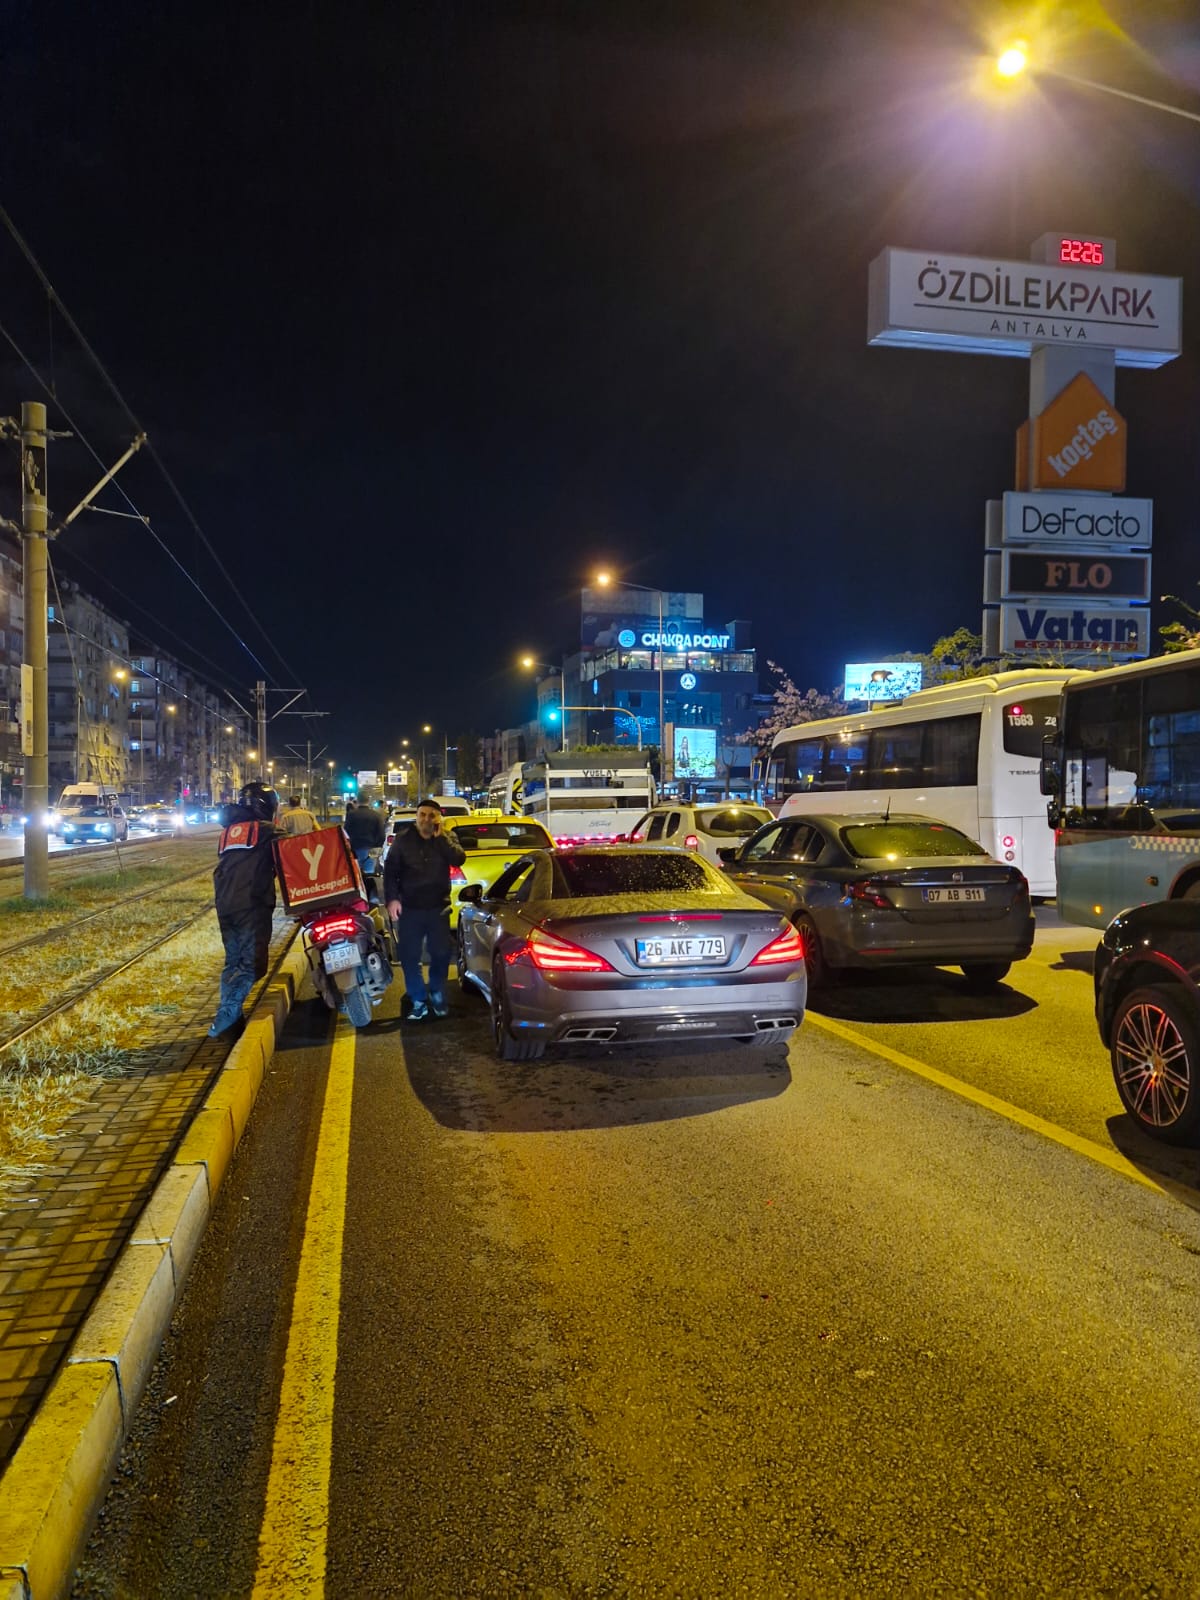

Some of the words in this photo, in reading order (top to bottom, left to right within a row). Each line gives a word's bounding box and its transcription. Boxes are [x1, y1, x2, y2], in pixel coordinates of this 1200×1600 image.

[917, 260, 1155, 319] ÖZDİLEKPARK
[990, 319, 1087, 339] ANTALYA
[1046, 408, 1119, 478] koçtaş
[1022, 505, 1141, 538] DeFacto
[1044, 561, 1113, 588] FLO
[1015, 608, 1139, 642] Vatan
[641, 632, 692, 648] CHAKRA
[693, 634, 730, 649] POINT
[301, 843, 325, 881] Y
[290, 875, 349, 898] Yemeksepeti
[928, 891, 941, 901] 07
[947, 890, 960, 900] AB
[964, 889, 981, 900] 911
[646, 942, 662, 956] 26
[670, 941, 692, 955] AKF
[698, 940, 722, 954] 779
